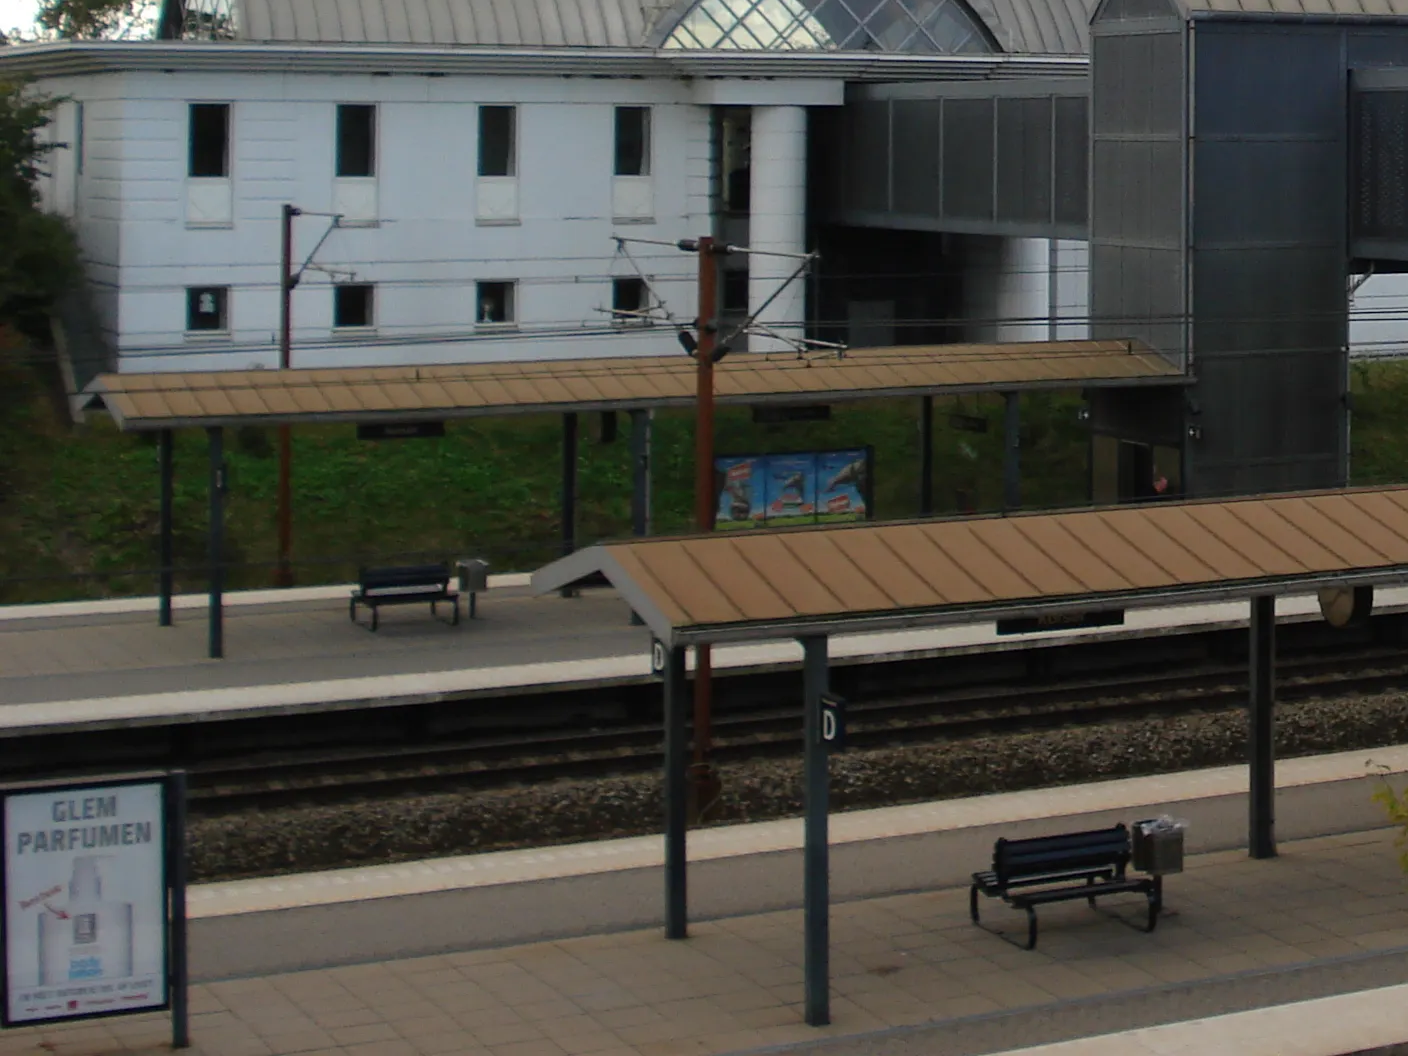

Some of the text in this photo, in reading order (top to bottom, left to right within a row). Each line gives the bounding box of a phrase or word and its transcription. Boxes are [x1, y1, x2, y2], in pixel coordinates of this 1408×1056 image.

[823, 709, 836, 740] D
[51, 796, 117, 823] GLEM
[17, 821, 152, 855] PARFUMEN
